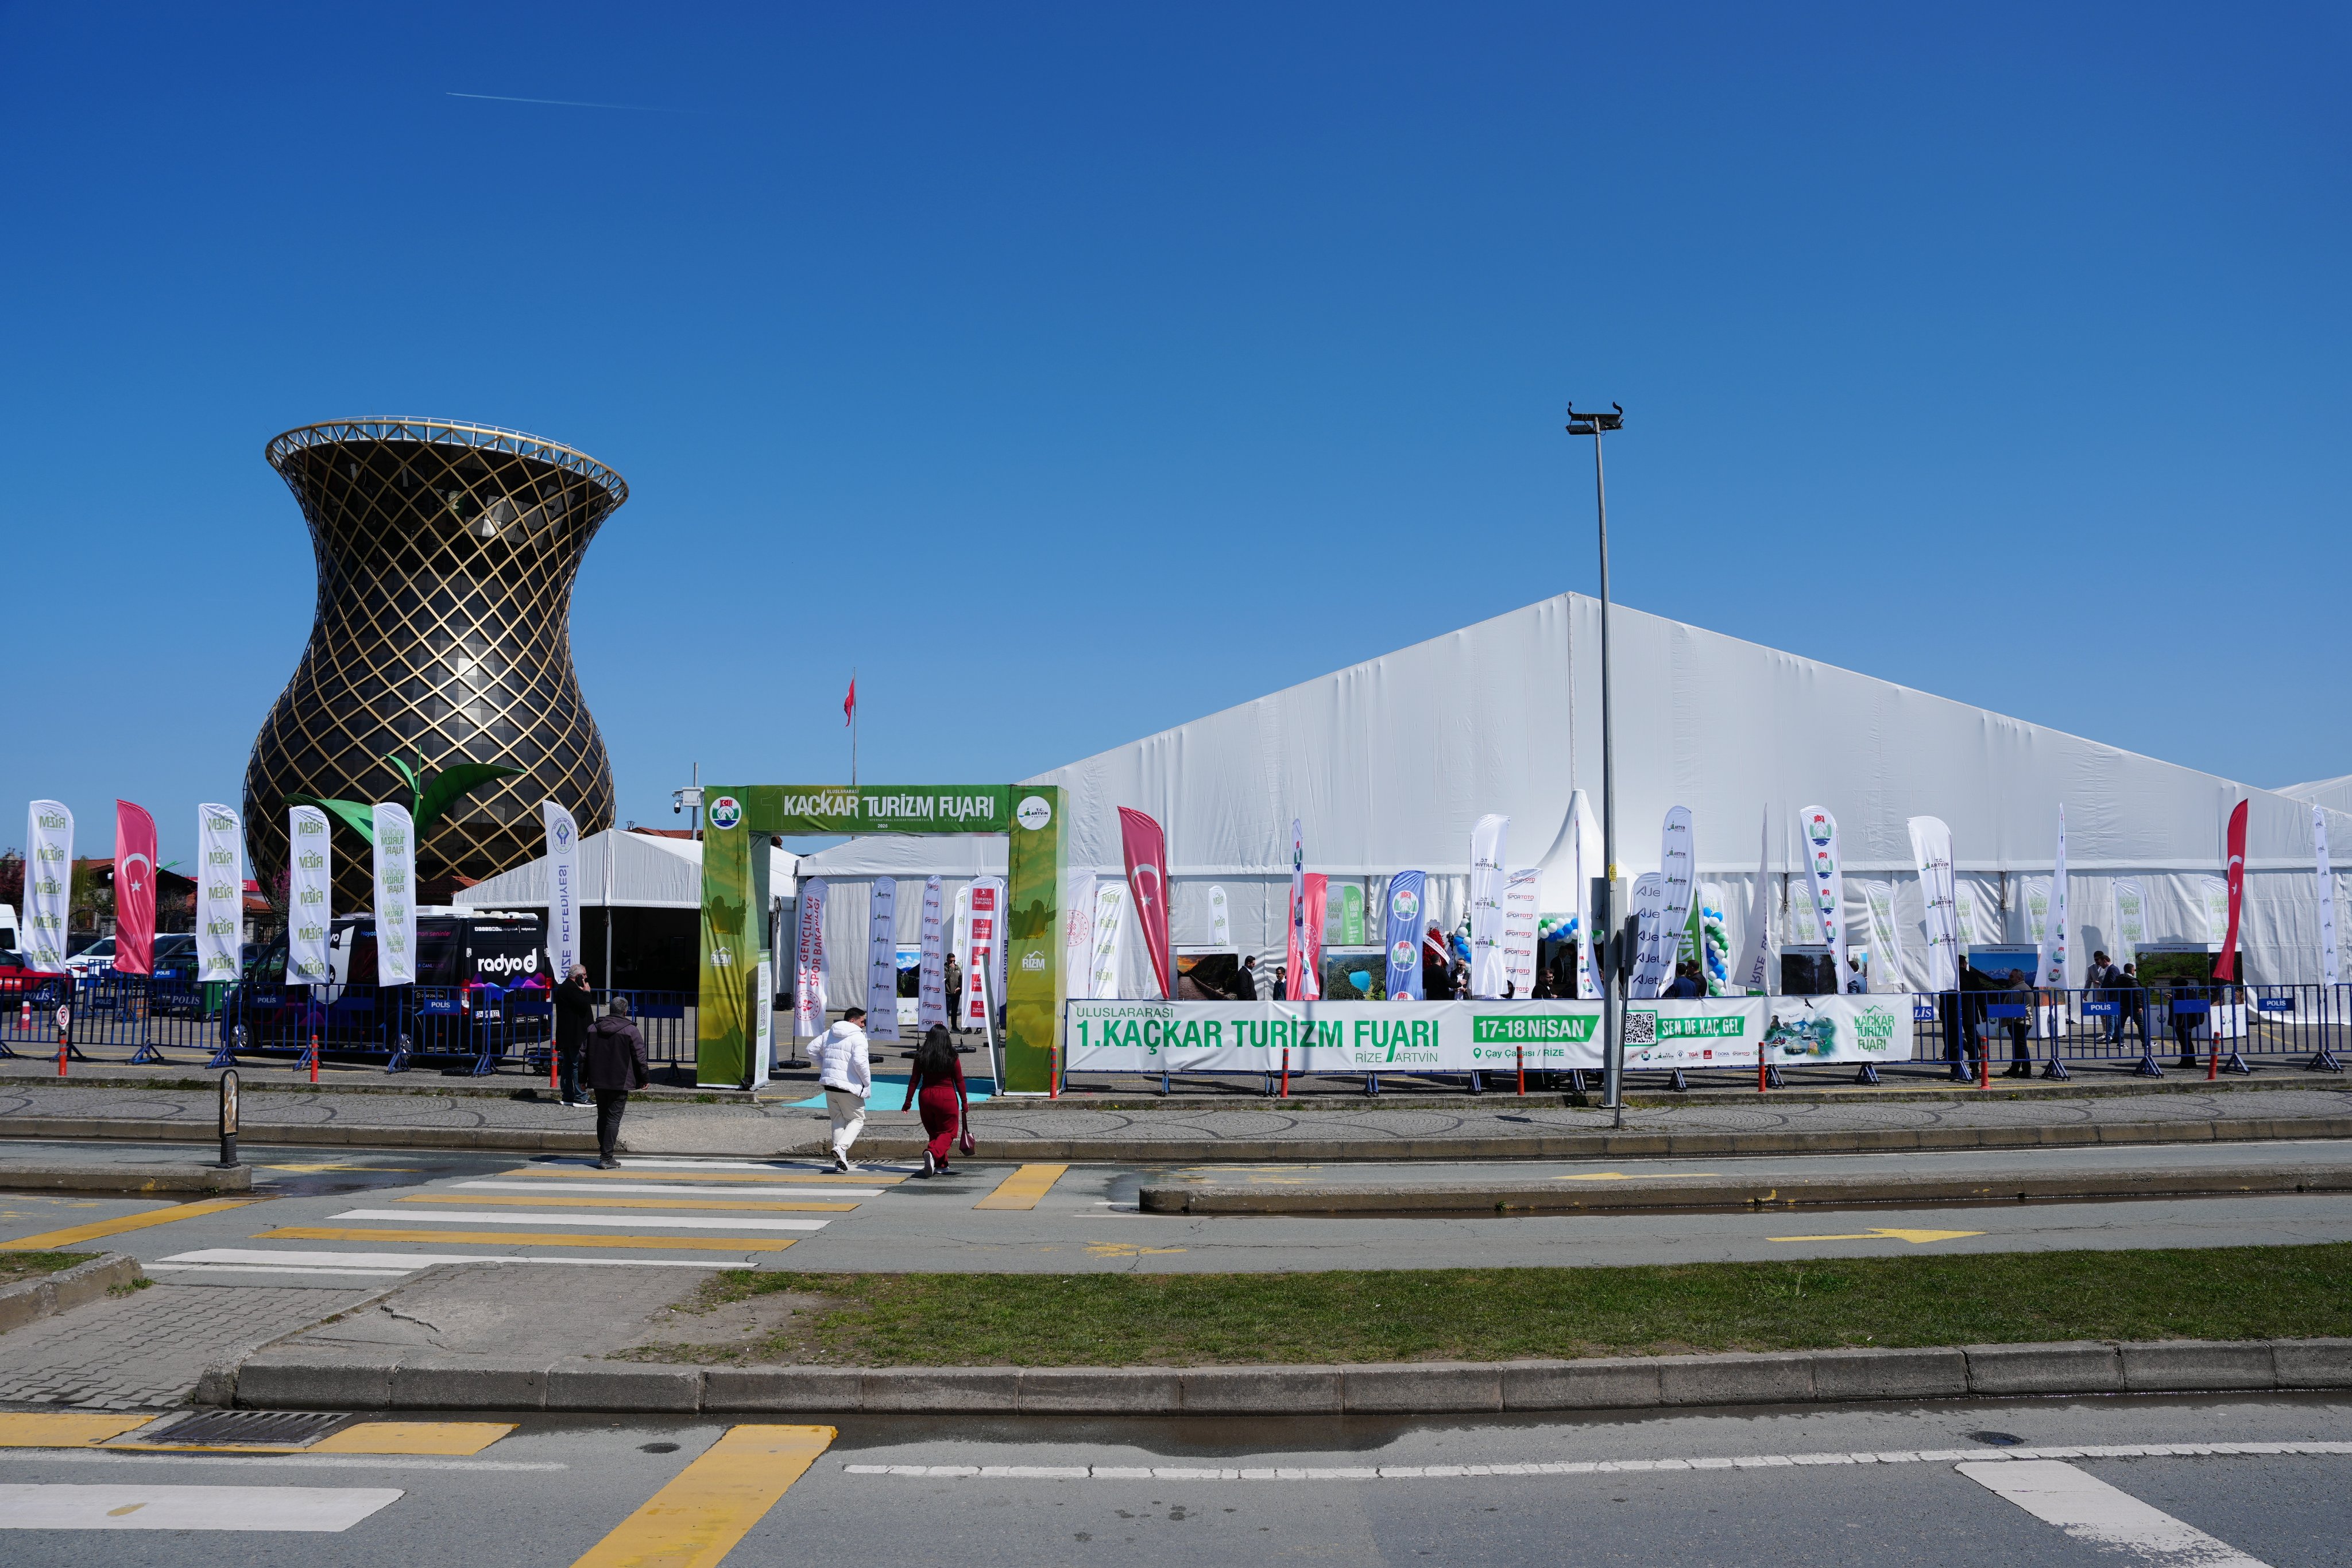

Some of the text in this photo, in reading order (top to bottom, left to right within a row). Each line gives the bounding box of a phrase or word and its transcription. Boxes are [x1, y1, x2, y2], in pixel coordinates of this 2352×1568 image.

[862, 793, 934, 822] TURİZM
[939, 796, 994, 822] FUARI
[1636, 885, 1660, 896] AJe
[1638, 907, 1659, 919] AJe
[798, 895, 813, 985] T.C. GENÇLİK VE
[1638, 930, 1659, 942] AJe
[810, 958, 821, 986] SPOR
[1633, 973, 1658, 985] AJet
[24, 991, 50, 1001] POLİS
[172, 995, 200, 1005] POLİS
[2091, 1003, 2111, 1012] POLİS
[2266, 999, 2286, 1007] POLİS
[1077, 1008, 1173, 1018] ULUSLARARASI
[1914, 1007, 1932, 1018] LİS
[1479, 1020, 1525, 1038] 17-18
[1662, 1019, 1739, 1037] SEN DE KAÇ GEL
[1854, 1025, 1893, 1039] TURİZM
[1232, 1015, 1343, 1048] TURİZM
[1355, 1020, 1438, 1062] FUARI
[1858, 1039, 1886, 1052] FUARI
[1355, 1050, 1438, 1062] RİZE ARTVİN
[1486, 1050, 1502, 1058] Çay
[1505, 1049, 1535, 1058] Çaşısı
[1544, 1047, 1564, 1056] RİZE
